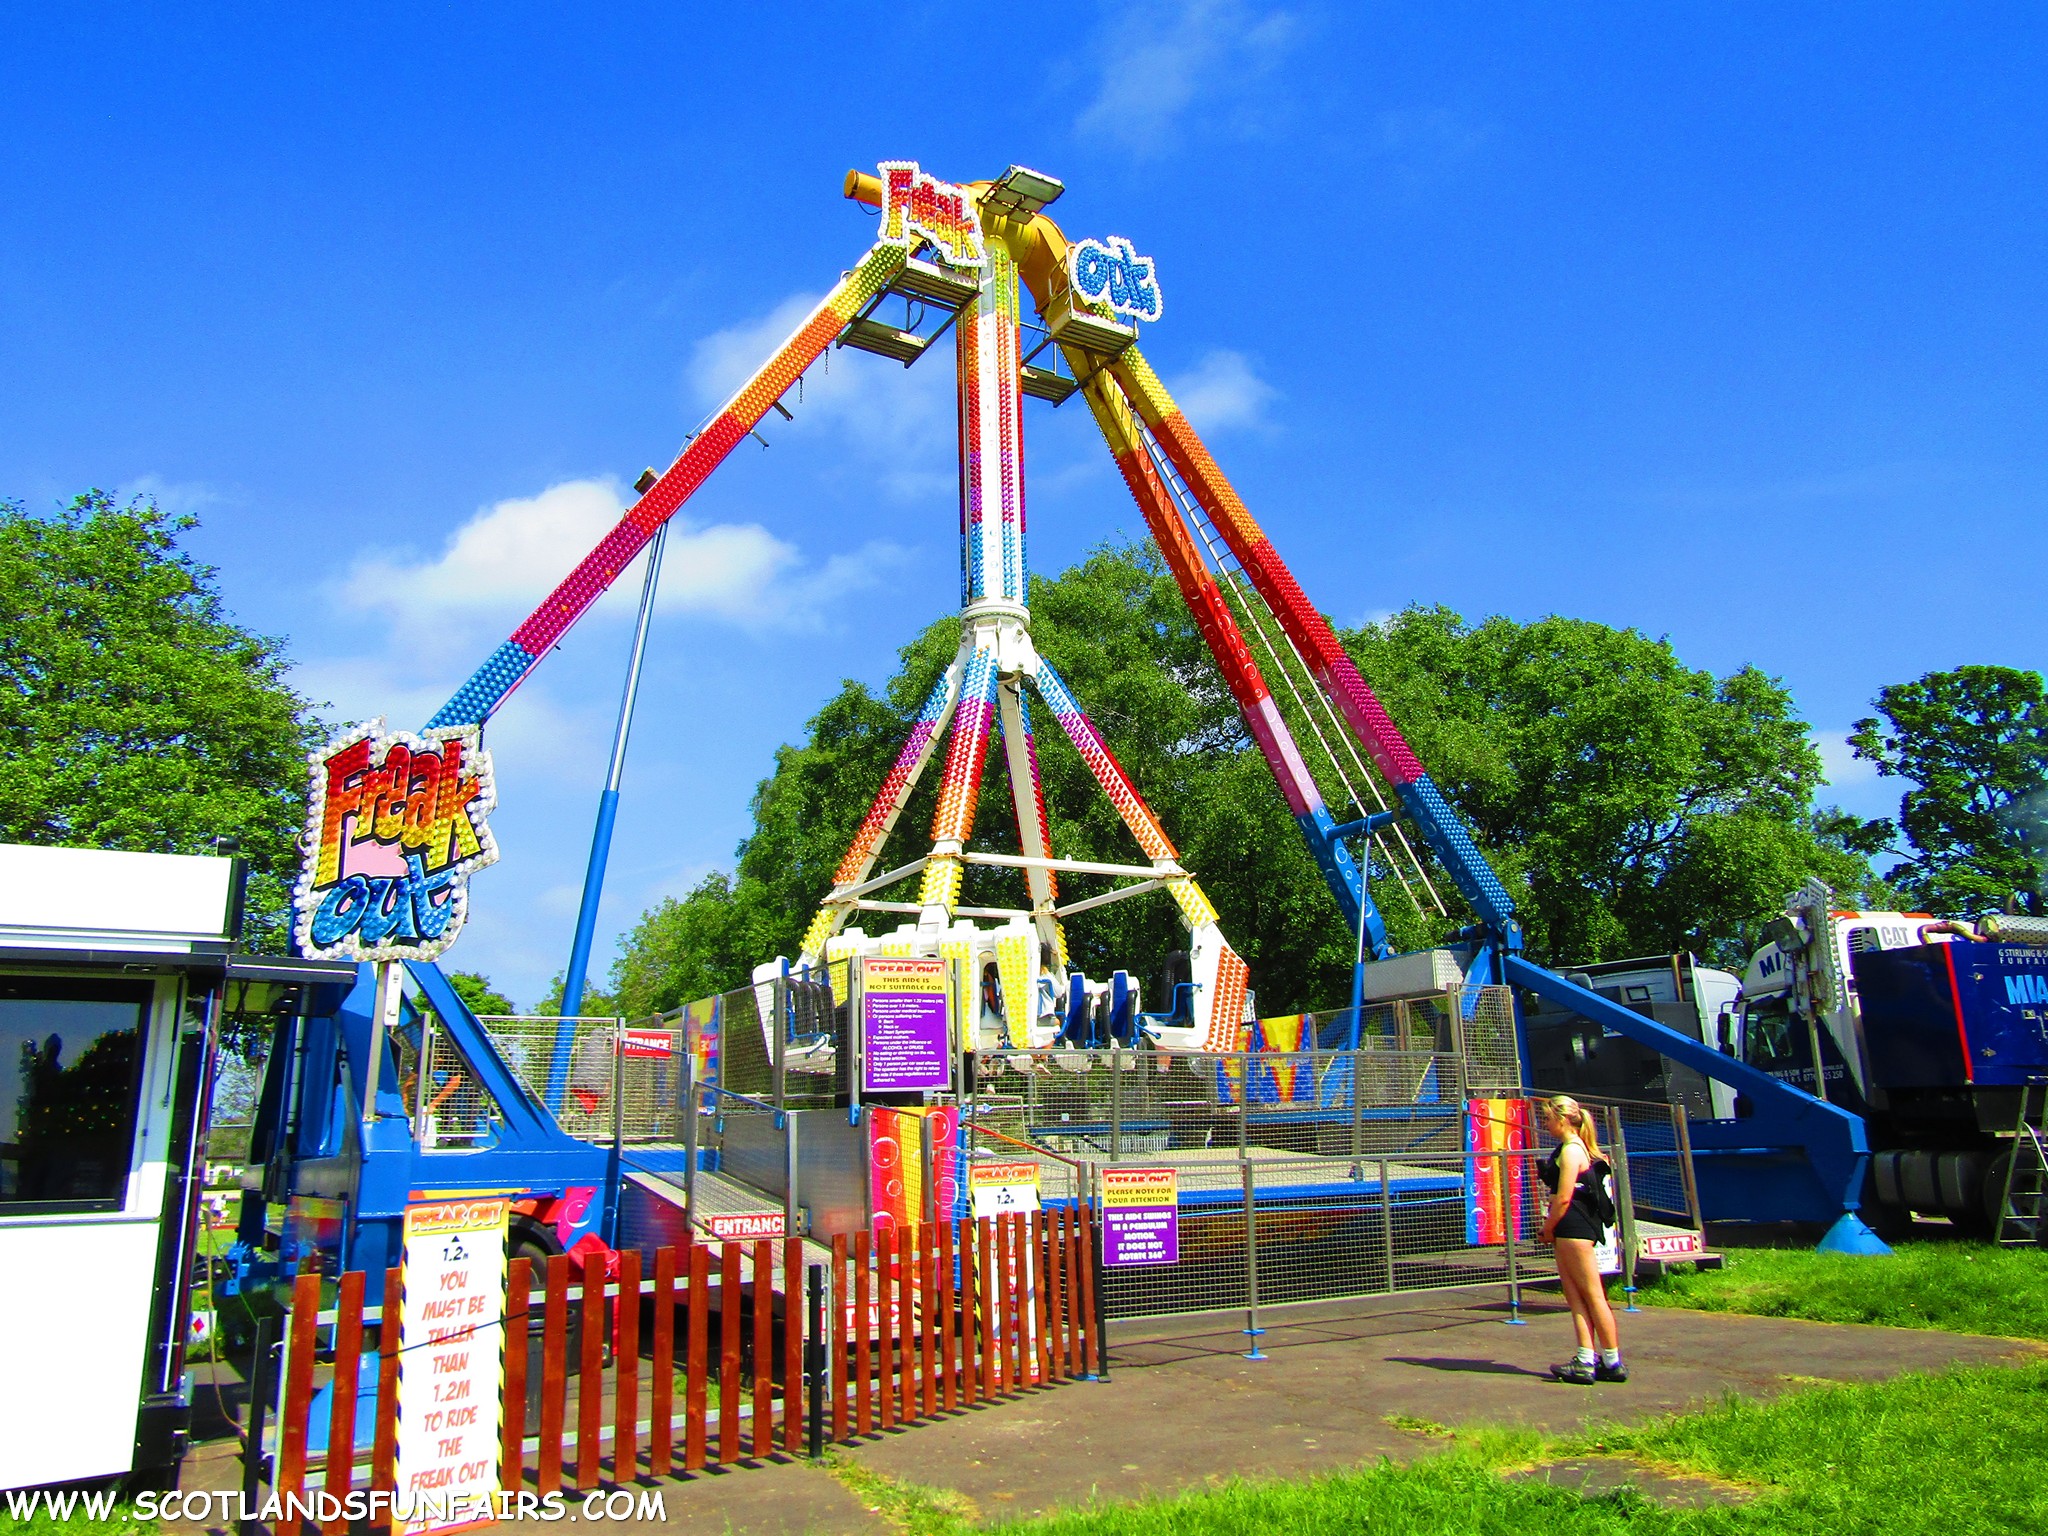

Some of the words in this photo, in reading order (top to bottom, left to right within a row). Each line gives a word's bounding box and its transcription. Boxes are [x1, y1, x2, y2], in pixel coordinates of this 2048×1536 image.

[888, 170, 979, 259] Freak
[315, 737, 481, 888] Freak
[1881, 926, 1908, 946] CAT
[1998, 949, 2004, 957] G
[2005, 949, 2036, 957] STIRLING
[2036, 949, 2042, 957] &
[870, 962, 914, 976] FREAK
[916, 962, 942, 976] OUT
[624, 1037, 670, 1051] NTRANCE
[1107, 1172, 1146, 1186] FREAK
[1149, 1172, 1172, 1186] OUT
[410, 1207, 467, 1232] FREAK
[469, 1202, 504, 1228] OUT
[1650, 1237, 1690, 1253] EXIT
[439, 1270, 468, 1291] YOU
[422, 1299, 467, 1321] MUST
[468, 1295, 486, 1315] BE
[428, 1323, 478, 1347] TALLER
[433, 1351, 470, 1374] THAN
[434, 1379, 471, 1402] 1.2M
[424, 1411, 443, 1432] TO
[446, 1405, 479, 1429] RIDE
[438, 1436, 463, 1459] THE
[409, 1466, 456, 1492] FREAK
[458, 1459, 489, 1484] OUT
